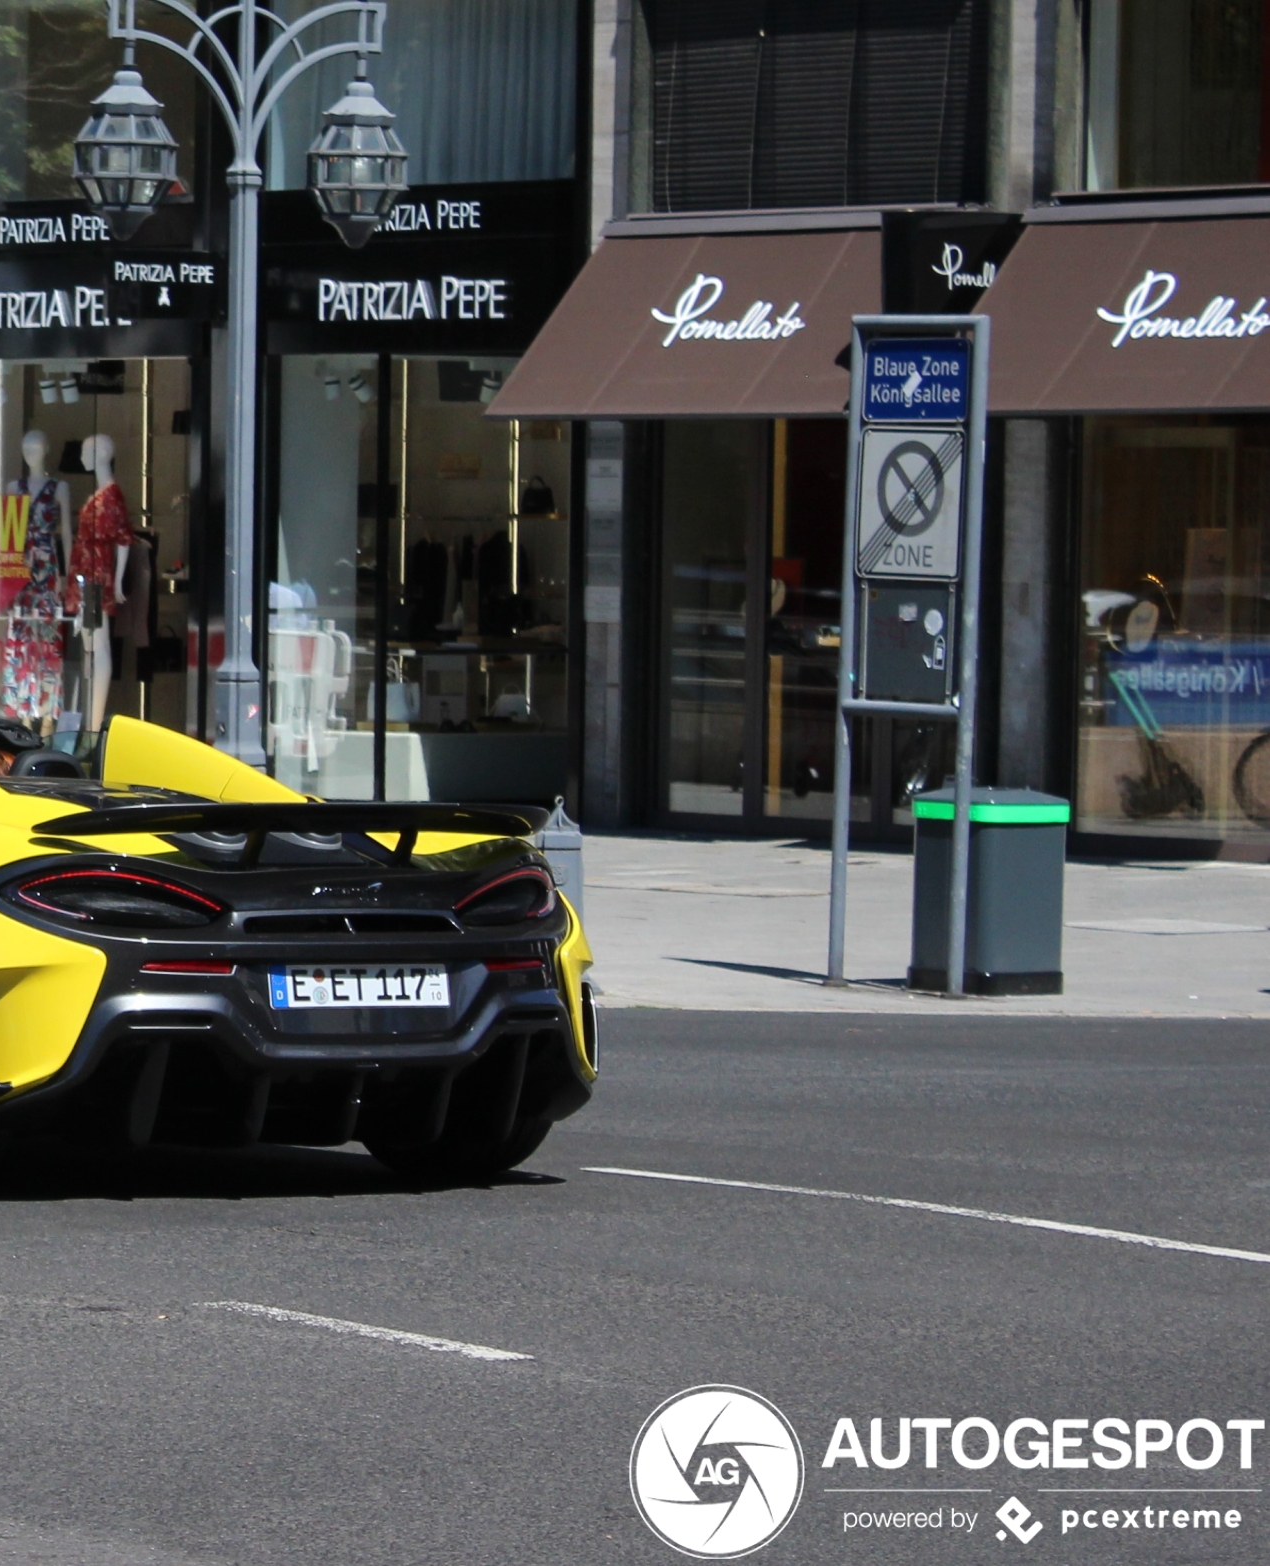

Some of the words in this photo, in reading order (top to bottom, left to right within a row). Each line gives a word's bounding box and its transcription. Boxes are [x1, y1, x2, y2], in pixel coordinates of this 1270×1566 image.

[437, 200, 480, 229] PEPE
[114, 261, 176, 283] PATRIZIA
[180, 263, 214, 284] PEPE
[931, 242, 995, 290] Pomell
[318, 278, 435, 321] PATRIZIA
[441, 276, 507, 320] PEPE
[651, 273, 805, 348] Pomellato
[1096, 270, 1270, 348] Pomellato
[874, 357, 917, 377] Blaue
[922, 356, 961, 377] Zone
[883, 544, 933, 568] ZONE
[276, 990, 284, 1001] D
[291, 969, 311, 1002] E
[330, 968, 368, 1001] ET
[375, 968, 427, 1001] 117
